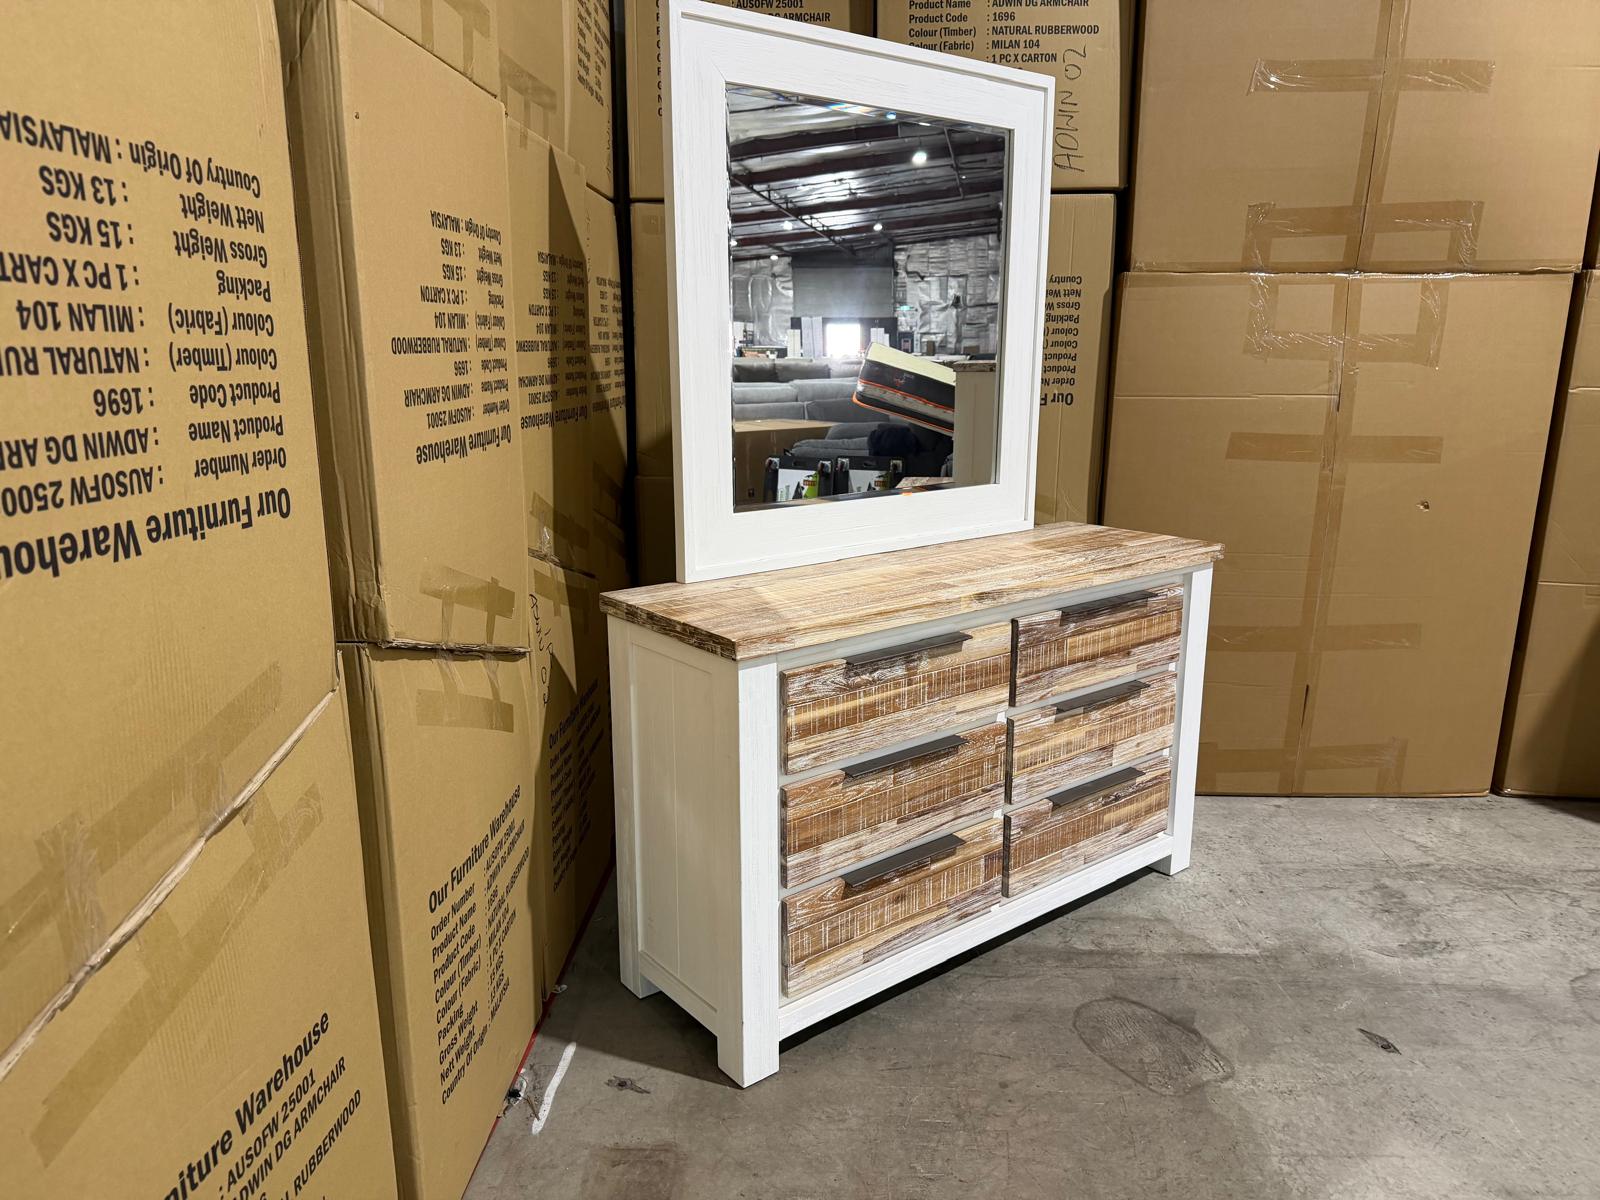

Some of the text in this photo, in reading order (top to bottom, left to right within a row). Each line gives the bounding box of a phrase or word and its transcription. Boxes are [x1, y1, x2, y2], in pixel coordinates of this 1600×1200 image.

[909, 0, 943, 9] Product
[946, 0, 971, 8] Name
[909, 12, 1015, 24] Product Code 1696
[909, 24, 1099, 38] Colour (Timber) NATURAL RUBBERWOOD
[940, 40, 974, 52] (Fabric)
[992, 40, 1020, 49] MILAN
[1024, 39, 1040, 48] 104
[999, 53, 1011, 63] PC
[1013, 53, 1019, 62] X
[1021, 52, 1057, 62] CARTON
[0, 110, 261, 198] Country Of Origin MALAYSIA
[38, 165, 265, 233] Nett Weight 13 KGS
[430, 210, 460, 233] MALAYSIA
[46, 211, 268, 269] Gross Weight 15 KGS
[440, 238, 453, 256] KGS
[454, 242, 462, 258] 13
[62, 258, 80, 287] X
[84, 260, 112, 290] PC
[115, 263, 128, 291] 1
[442, 264, 455, 281] KGS
[456, 266, 463, 282] 15
[1050, 274, 1082, 285] Country
[216, 270, 271, 303] Packing
[420, 285, 446, 303] CARTON
[1064, 289, 1081, 298] Nett
[16, 300, 274, 337] Colour (Fabric) MILAN 104
[1046, 312, 1080, 323] Packing
[1056, 302, 1081, 311] Gross
[434, 312, 466, 329] MILAN 104
[1050, 328, 1079, 336] Colour
[392, 336, 468, 355] NATURAL RUBBERWOOD
[1050, 340, 1078, 348] Colour
[0, 341, 278, 376] Colour (Timber) NATURAL RU
[454, 360, 468, 376] 1696
[1045, 353, 1077, 361] Product
[1044, 366, 1076, 374] Product
[1052, 378, 1075, 386] Order
[93, 381, 281, 417] Product Code 1696
[404, 387, 440, 407] ARMCHAIR
[452, 383, 470, 400] ADWIN
[1051, 392, 1074, 406] Our
[427, 410, 447, 430] 25001
[448, 406, 471, 426] AUSOFW
[520, 409, 555, 430] Warehouse
[0, 414, 284, 471] Product Name ADWIN DG AR
[416, 436, 468, 465] Warehouse
[469, 428, 500, 452] Furniture
[1, 447, 286, 517] Order Number AUSOFW 2500
[257, 487, 291, 519] Our
[146, 495, 253, 544] Furniture
[428, 784, 521, 914] Our Furniture Warehouse
[431, 911, 450, 941] Order
[452, 882, 475, 919] Number
[432, 922, 459, 964] Product
[460, 902, 477, 930] Name
[434, 942, 460, 984] Product
[460, 924, 476, 949] Code
[434, 970, 457, 1004] Colour
[458, 934, 482, 978] (Timber)
[436, 954, 482, 1025] Colour (Fabric)
[438, 1001, 464, 1046] Packing
[440, 1032, 458, 1066] Gross
[458, 1000, 478, 1035] Weight
[440, 1025, 476, 1086] Nett Weight
[235, 1012, 329, 1135] Warehouse
[442, 1061, 466, 1105] Country
[275, 1130, 292, 1162] DG
[294, 1056, 346, 1139] ARMCHAIR
[227, 1068, 316, 1193] AUSOFW 25001
[294, 1089, 361, 1193] RUBBERWOOD
